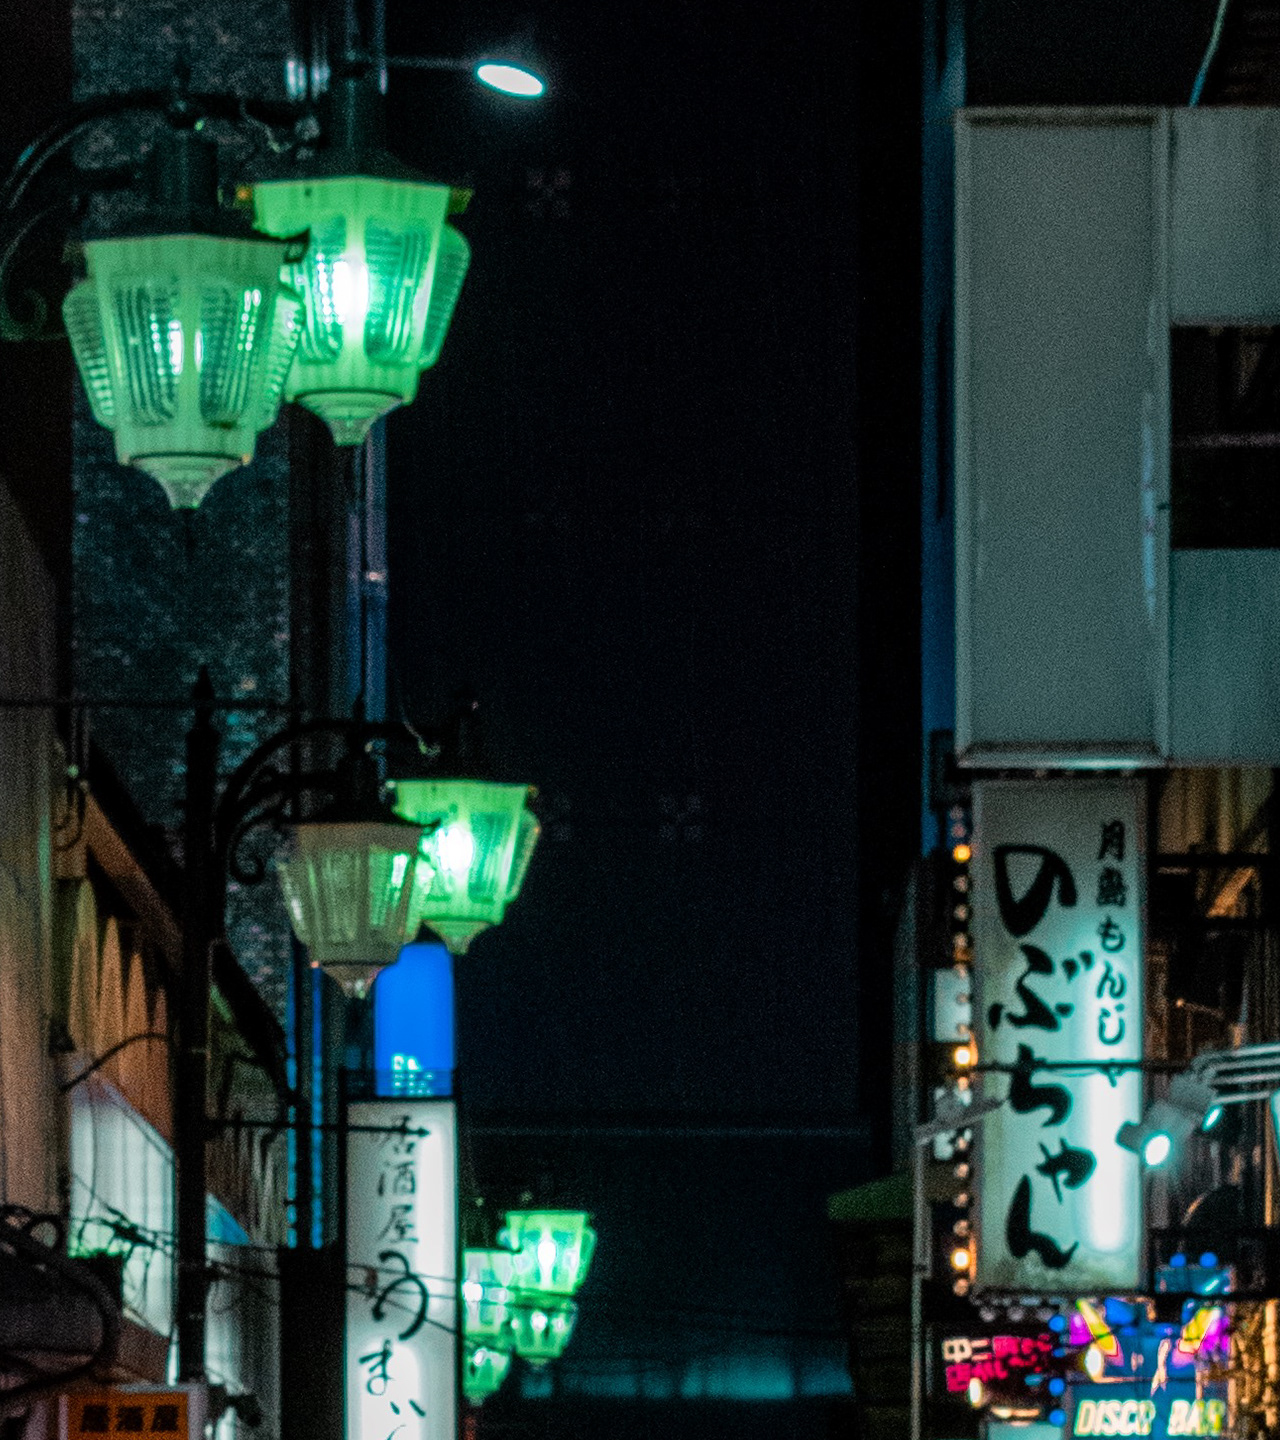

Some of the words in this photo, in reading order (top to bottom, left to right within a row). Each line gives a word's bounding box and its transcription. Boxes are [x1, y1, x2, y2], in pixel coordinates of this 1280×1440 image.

[987, 844, 1097, 1269] のぶちゃん
[1074, 1398, 1157, 1436] DISCO
[1167, 1398, 1226, 1436] BAR
